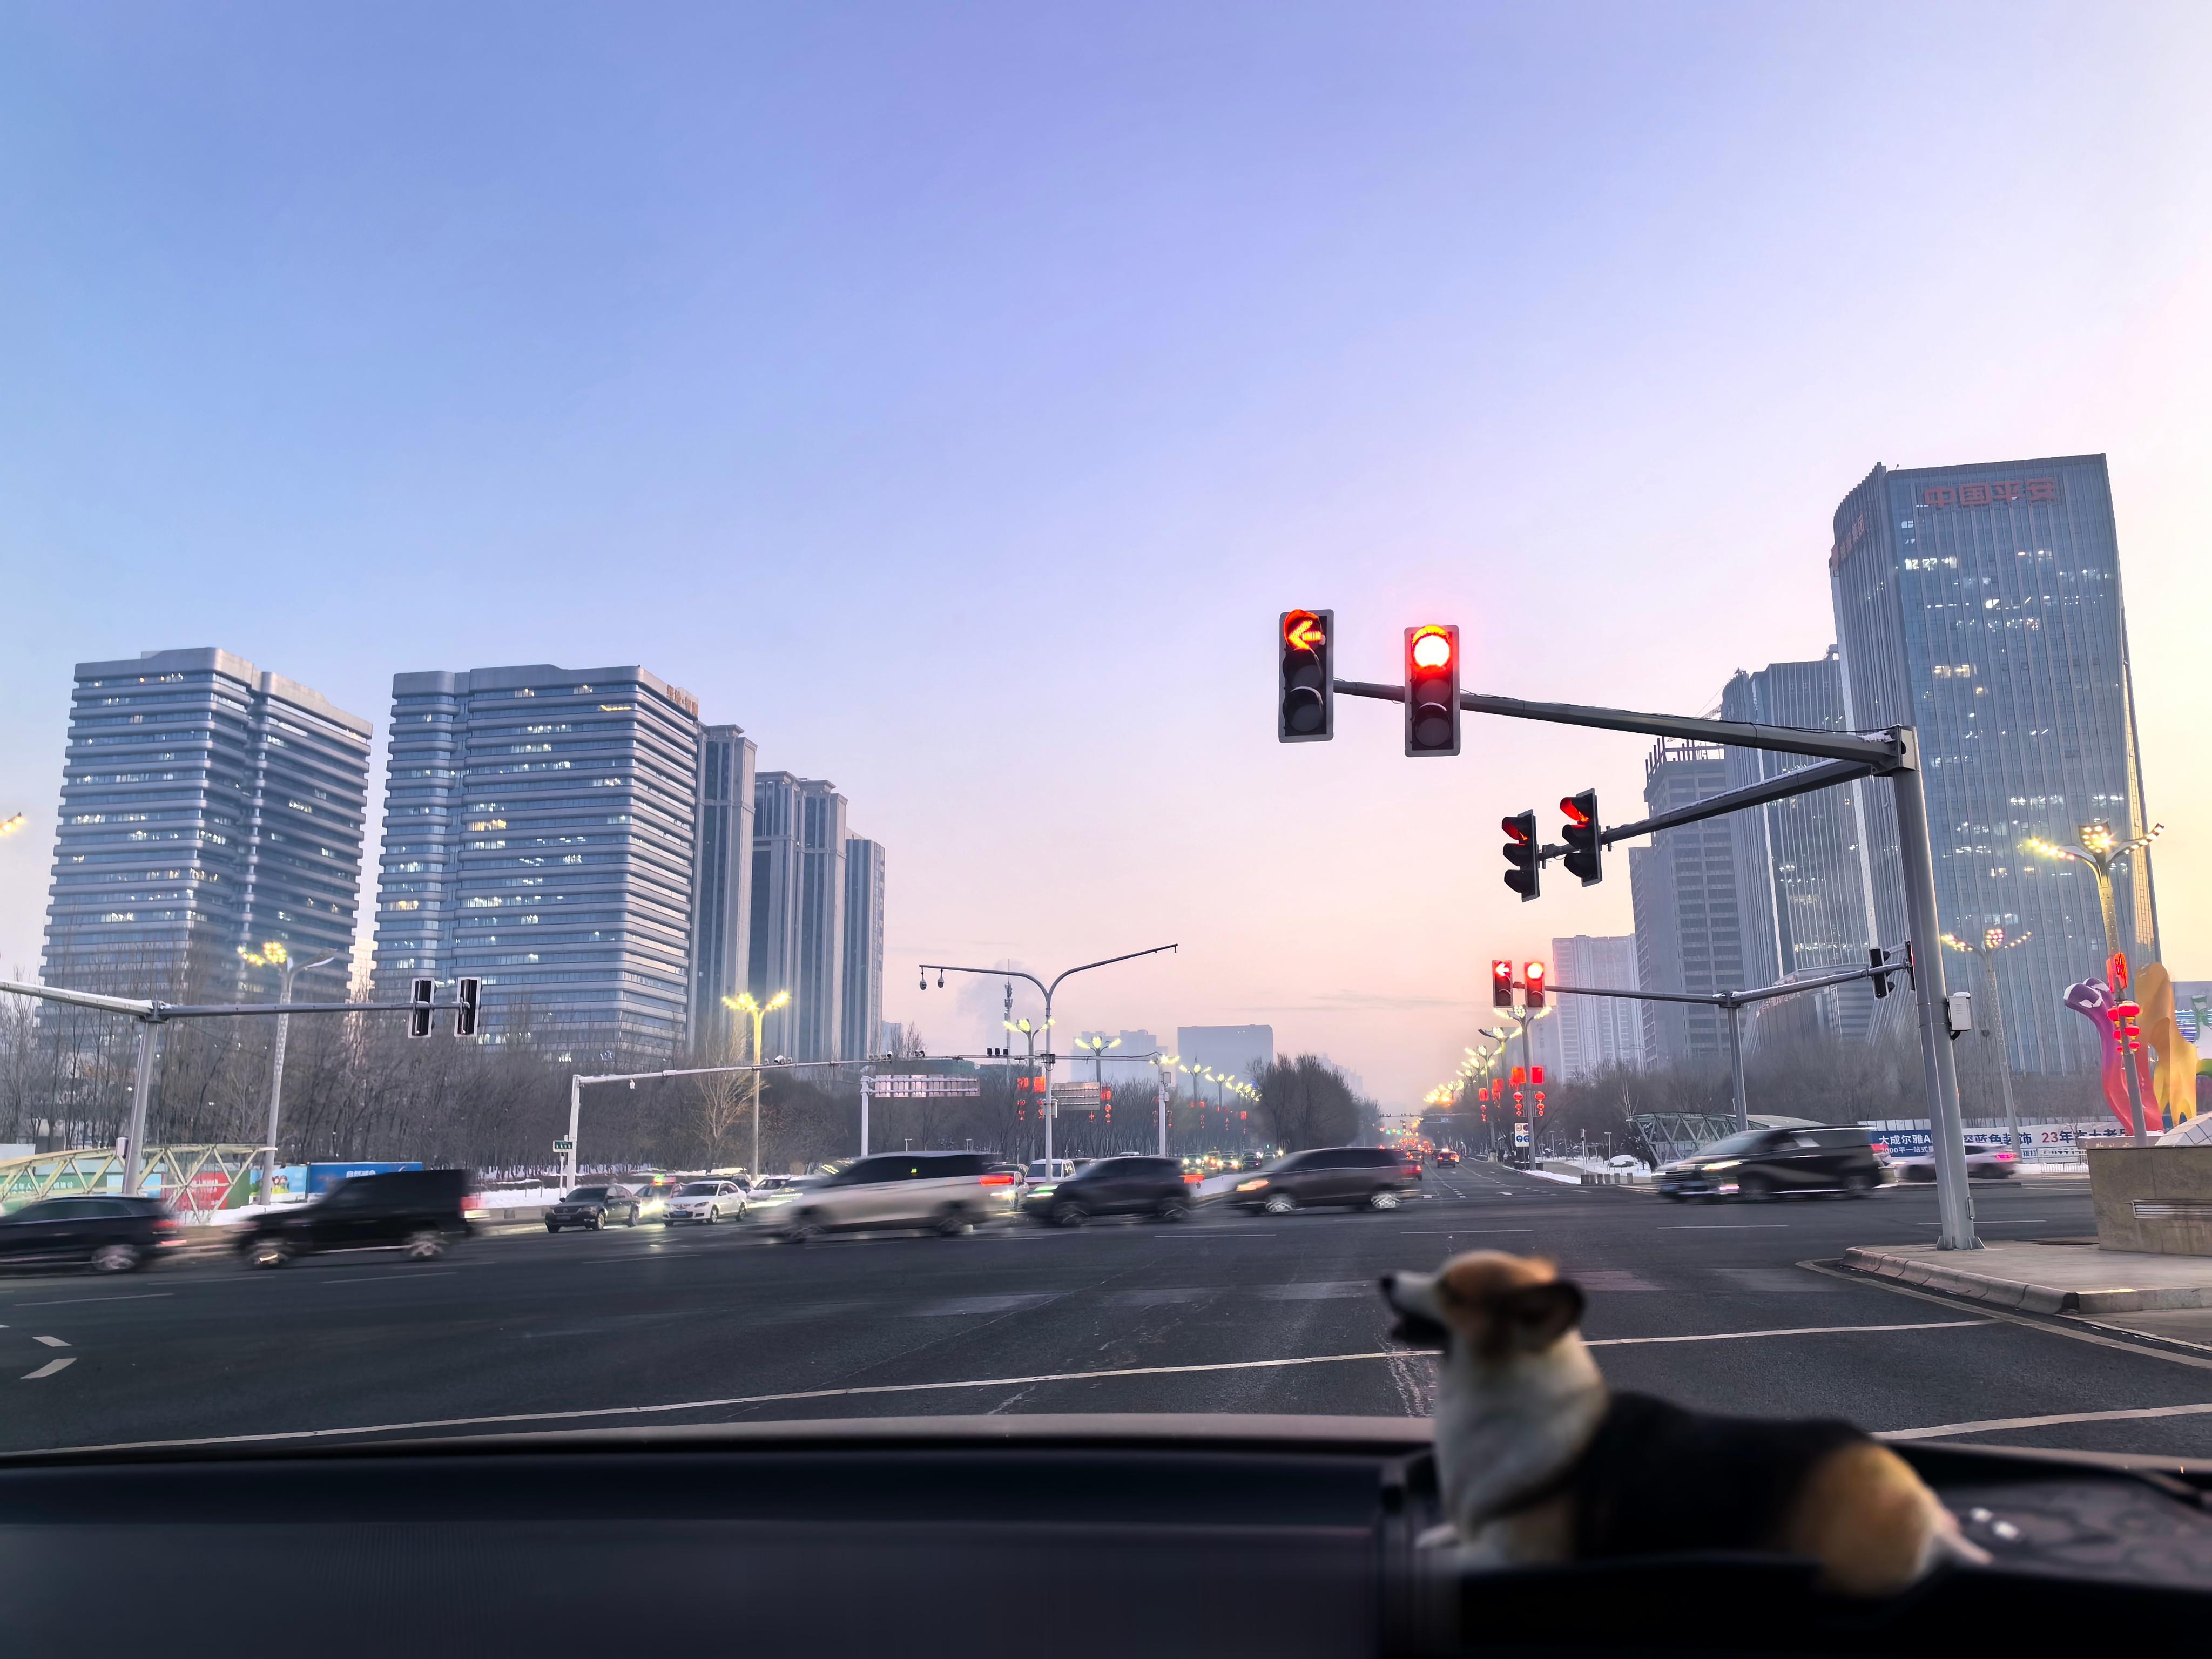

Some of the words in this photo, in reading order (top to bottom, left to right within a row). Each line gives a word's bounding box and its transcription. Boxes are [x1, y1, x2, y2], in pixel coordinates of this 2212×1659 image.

[1924, 477, 2057, 509] 中国平安
[1879, 1134, 1933, 1145] 大成尔雅A
